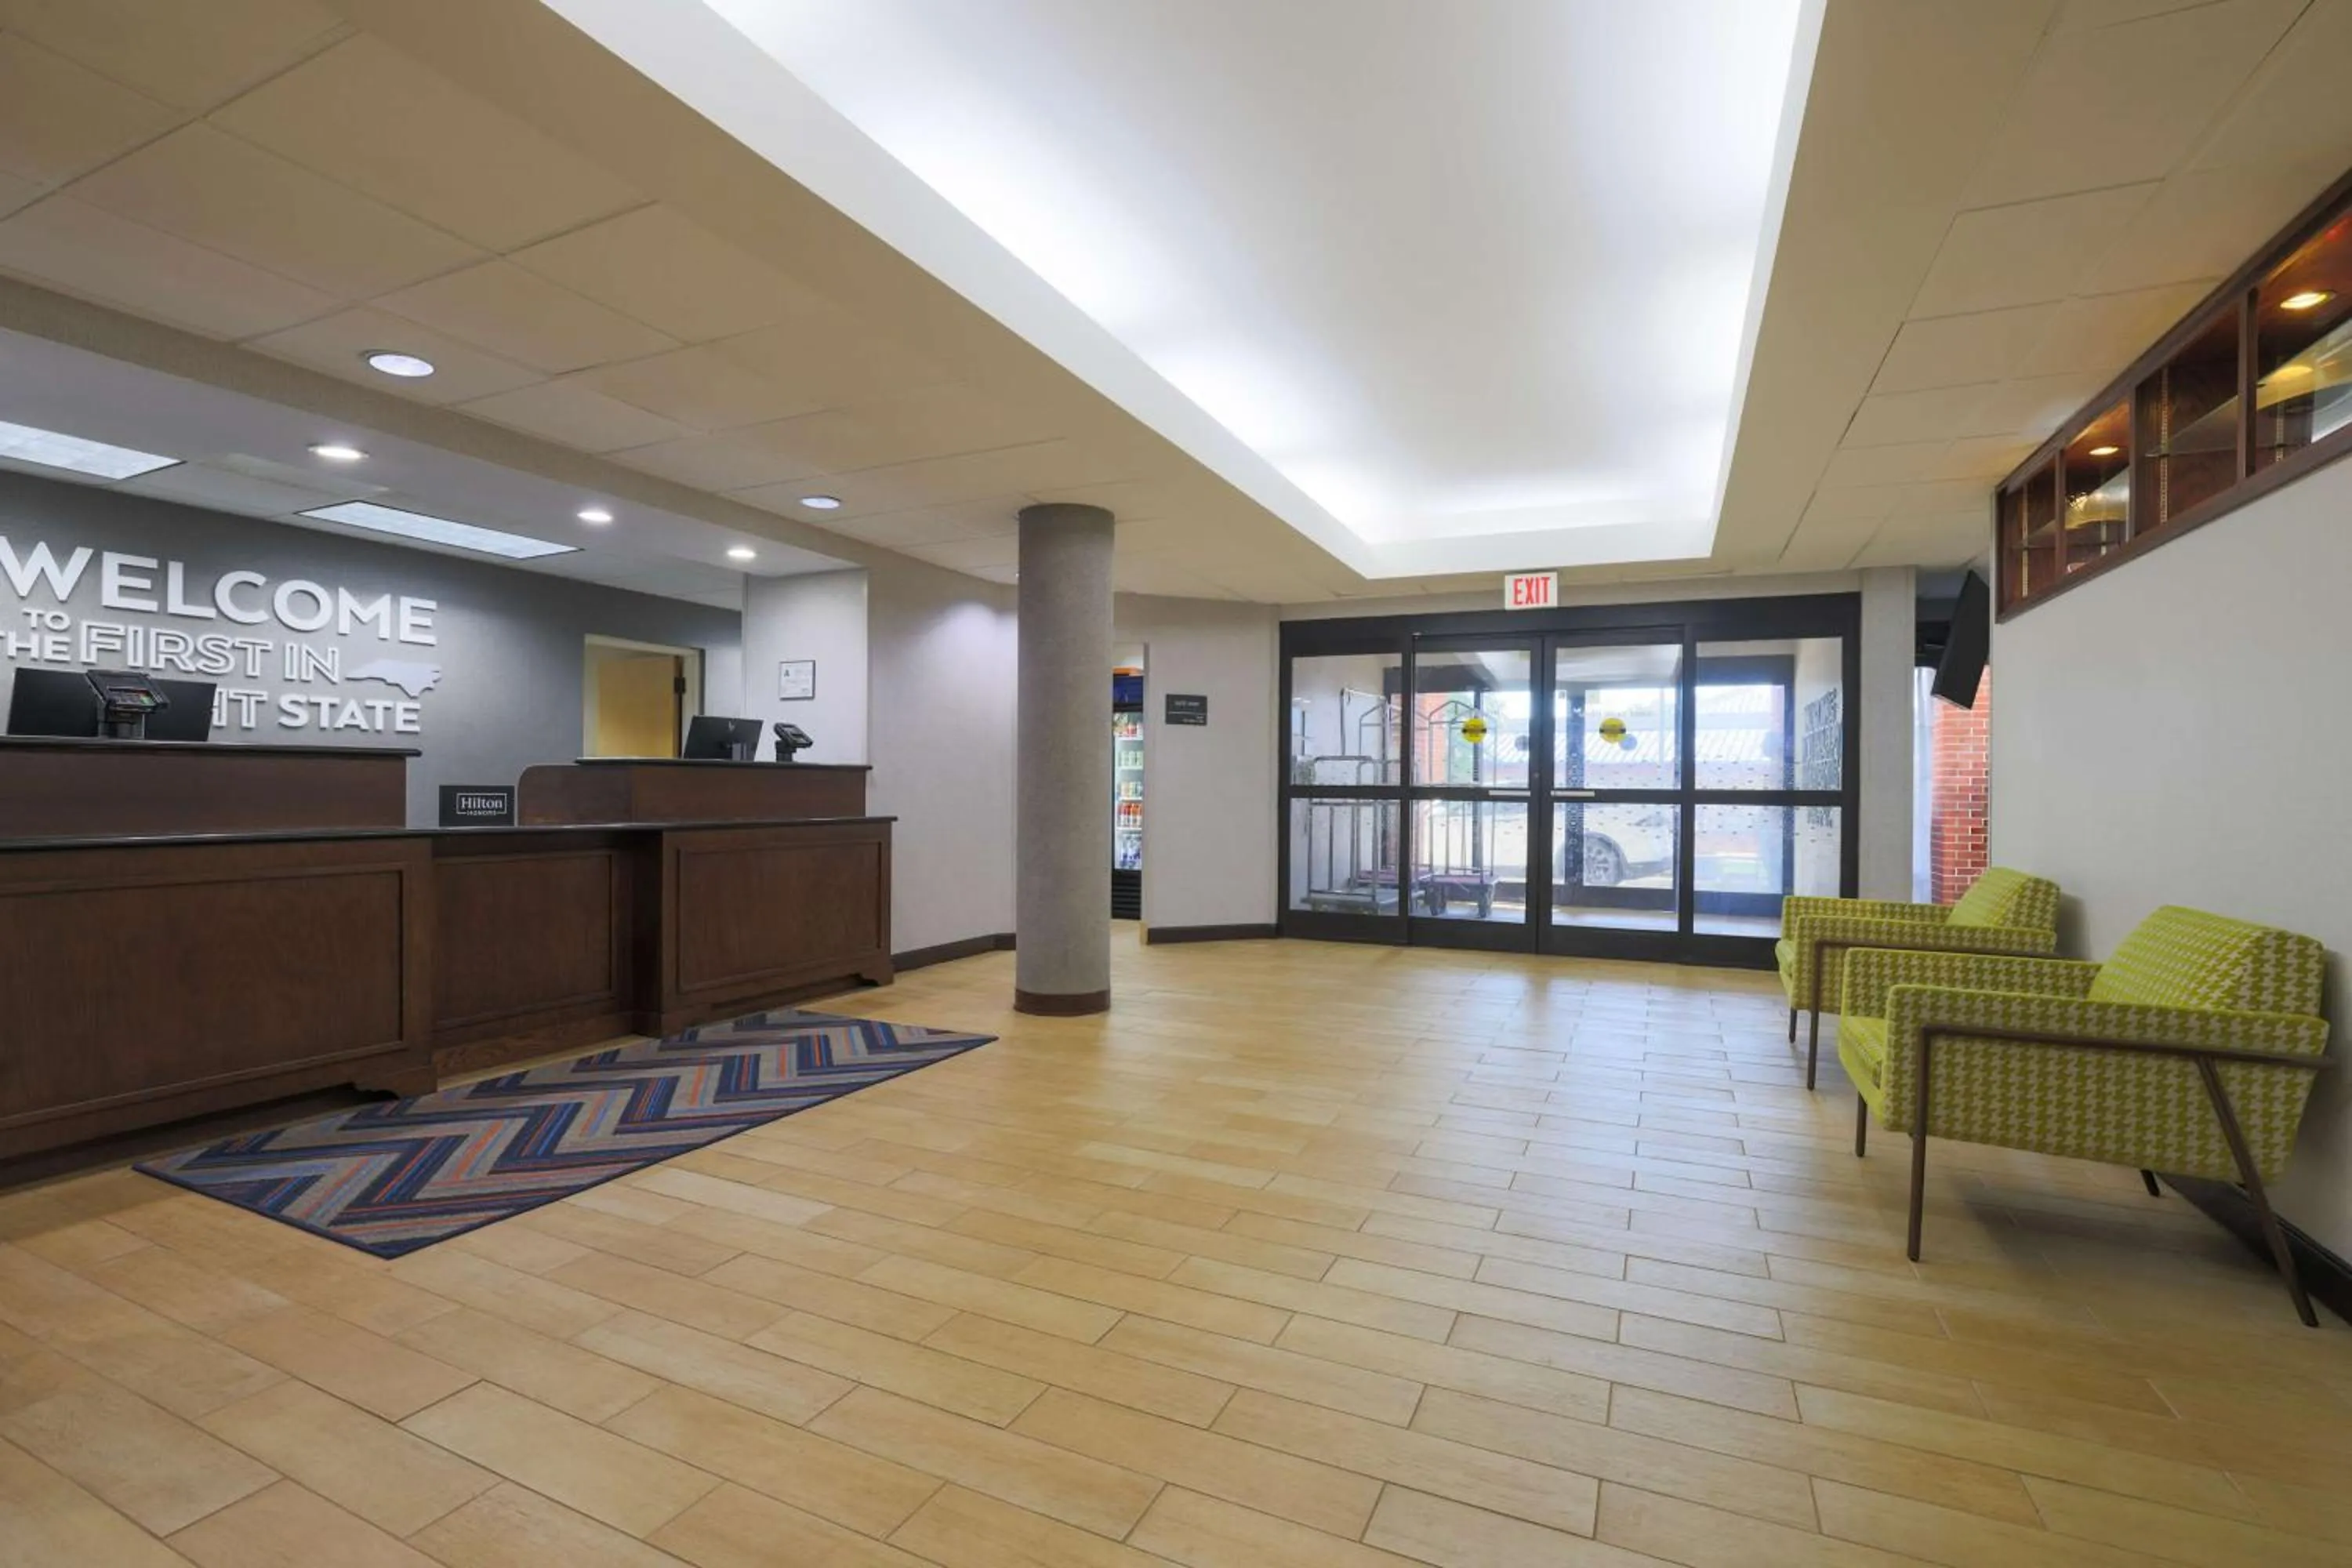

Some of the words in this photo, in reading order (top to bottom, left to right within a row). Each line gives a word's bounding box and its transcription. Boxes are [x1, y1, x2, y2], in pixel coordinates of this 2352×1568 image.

[0, 536, 437, 645] WELCOME
[1514, 577, 1550, 604] EXIT
[22, 608, 71, 631] TO
[81, 621, 271, 677] FIRST
[284, 643, 339, 684] IN
[278, 693, 420, 732] STATE
[461, 797, 503, 809] Hilton
